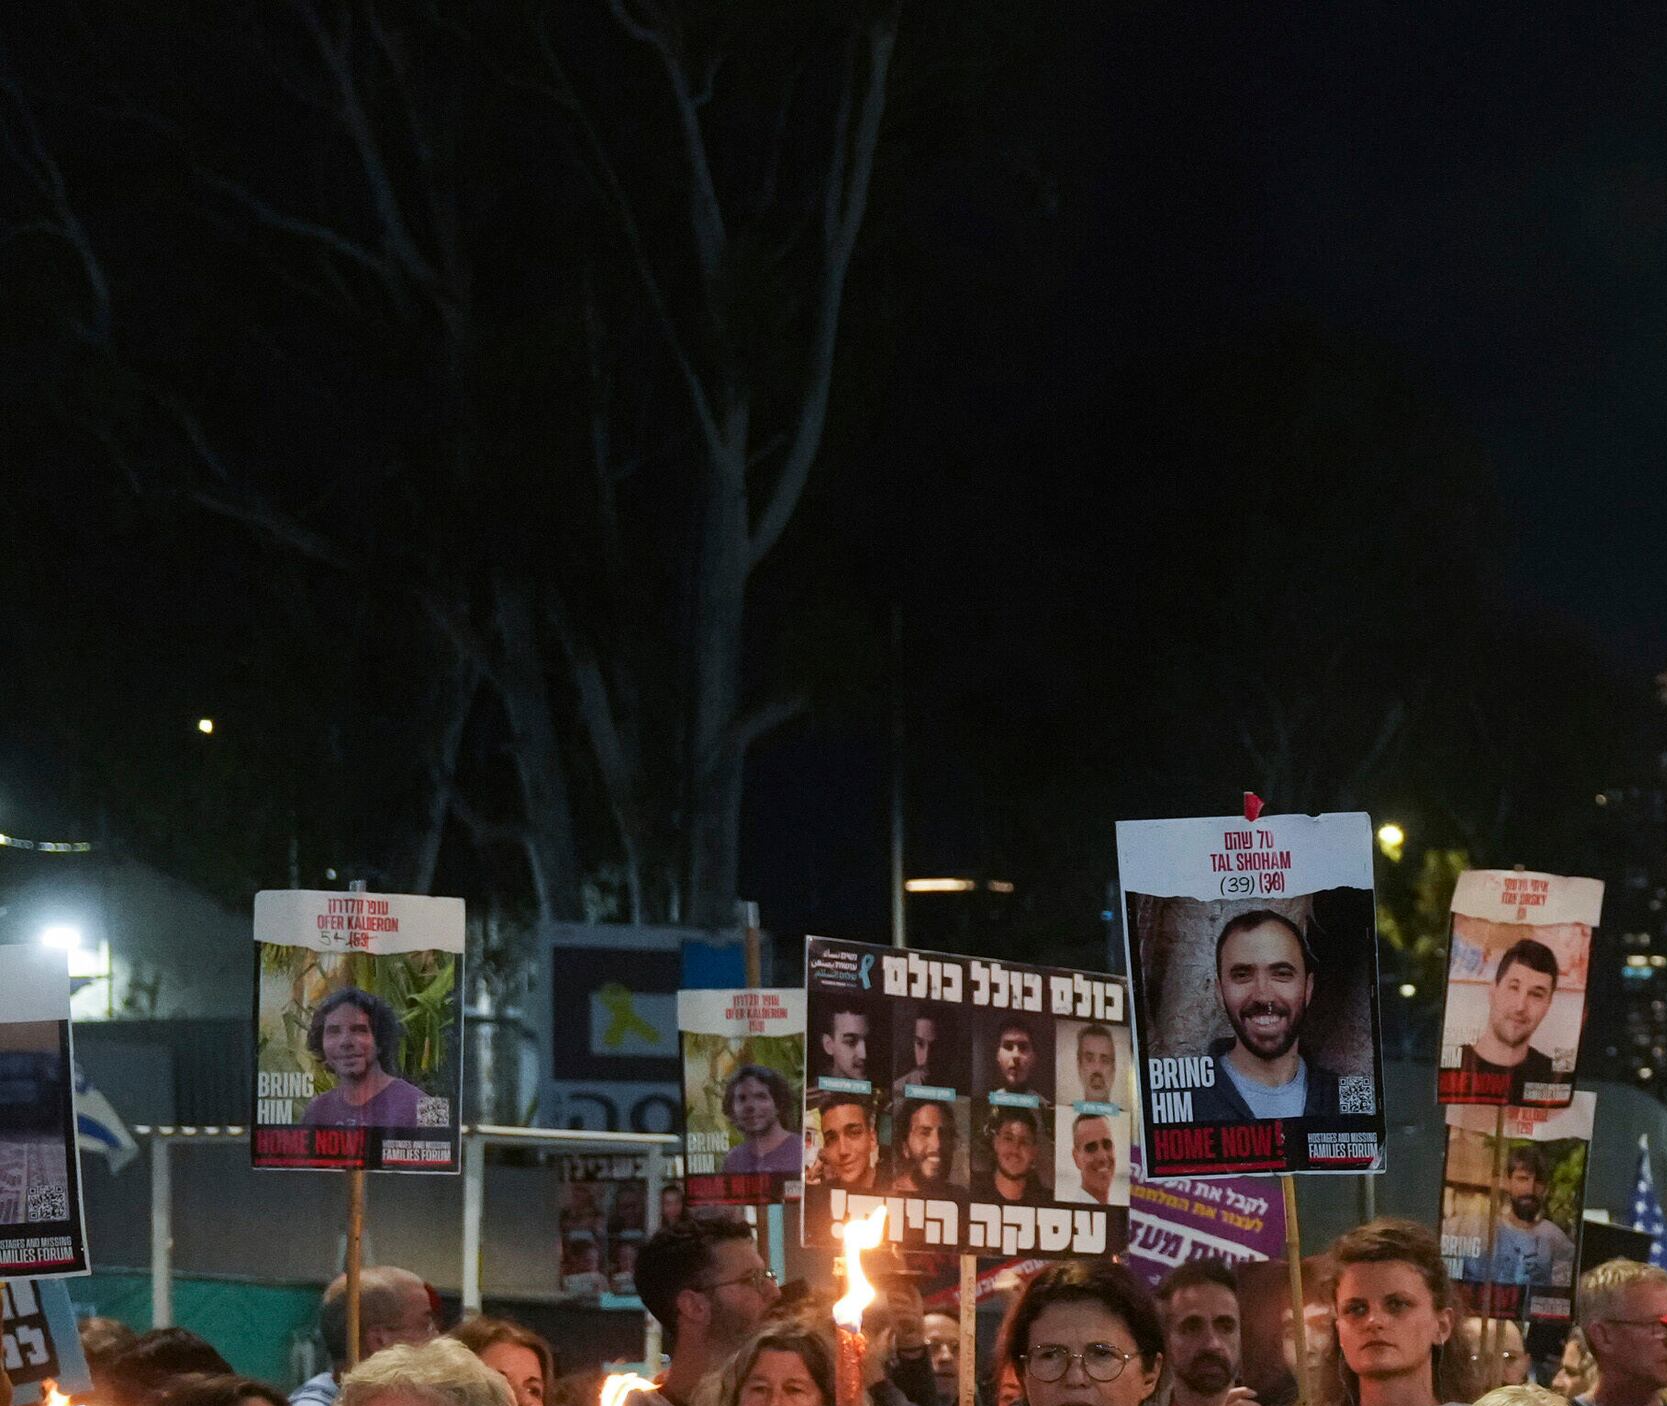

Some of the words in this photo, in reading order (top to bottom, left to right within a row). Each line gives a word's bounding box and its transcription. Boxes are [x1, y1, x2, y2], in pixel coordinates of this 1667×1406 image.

[1224, 830, 1253, 851] שהם
[1257, 829, 1274, 850] טל
[1210, 853, 1234, 872] TAL
[1236, 851, 1292, 872] SHOHAM
[1220, 875, 1255, 896] (39)
[317, 914, 344, 930] OFER
[347, 915, 399, 933] KALDERON
[882, 953, 963, 1003] כולם
[970, 960, 1043, 1013] כולל
[1050, 973, 1124, 1022] כולם
[1149, 1055, 1215, 1090] BRING
[257, 1071, 315, 1098] BRING
[257, 1099, 293, 1125] HIM
[1152, 1091, 1194, 1125] HIM
[256, 1129, 309, 1155] HOME
[315, 1129, 366, 1156] NOW!
[1154, 1126, 1216, 1162] HOME
[1221, 1120, 1285, 1157] NOW!
[1307, 1133, 1337, 1144] HOSTAGES
[1337, 1133, 1350, 1143] AND
[1350, 1132, 1377, 1143] MISSING
[382, 1150, 420, 1162] FAMILIES
[421, 1150, 451, 1162] FORUM
[1308, 1143, 1346, 1159] FAMILIES
[1348, 1143, 1379, 1159] FORUM
[969, 1202, 1107, 1256] עסקה
[25, 1238, 40, 1248] AND
[41, 1236, 73, 1247] MISSING
[38, 1246, 74, 1263] FORUM
